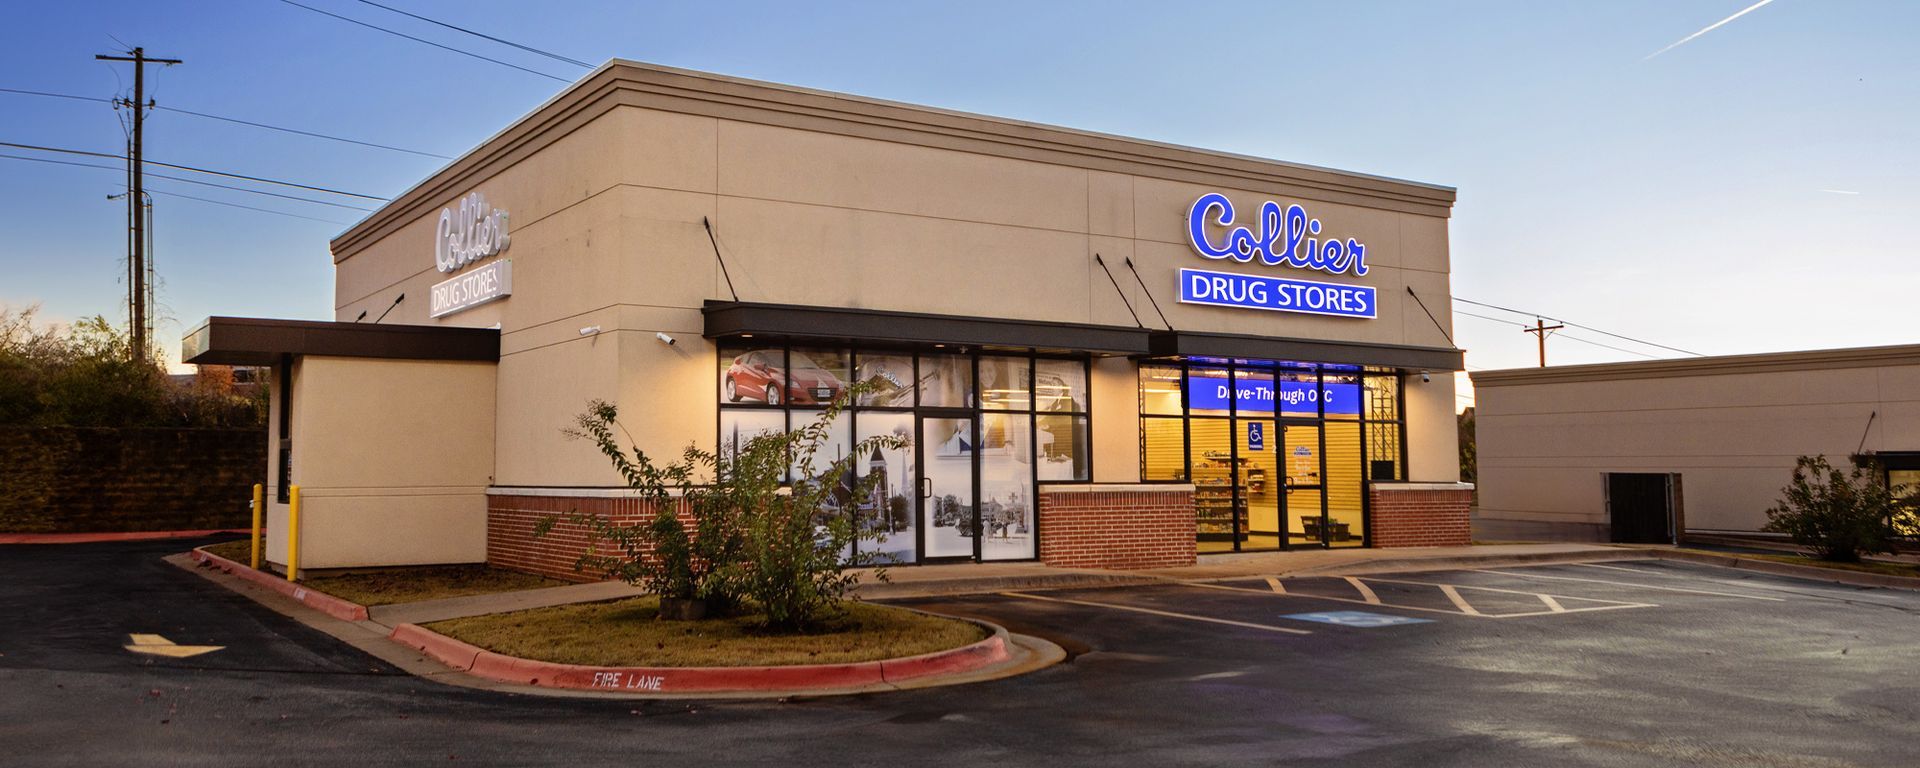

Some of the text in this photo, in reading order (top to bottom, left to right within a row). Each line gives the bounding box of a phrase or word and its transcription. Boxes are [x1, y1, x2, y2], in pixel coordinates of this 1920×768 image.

[435, 192, 506, 273] Collier
[1189, 193, 1369, 276] Collier
[433, 268, 498, 311] DRUG STORES
[1191, 274, 1367, 313] DRUG STORES
[1217, 385, 1333, 405] Dve-Thrugh OC
[592, 672, 664, 691] FIRE LANE
